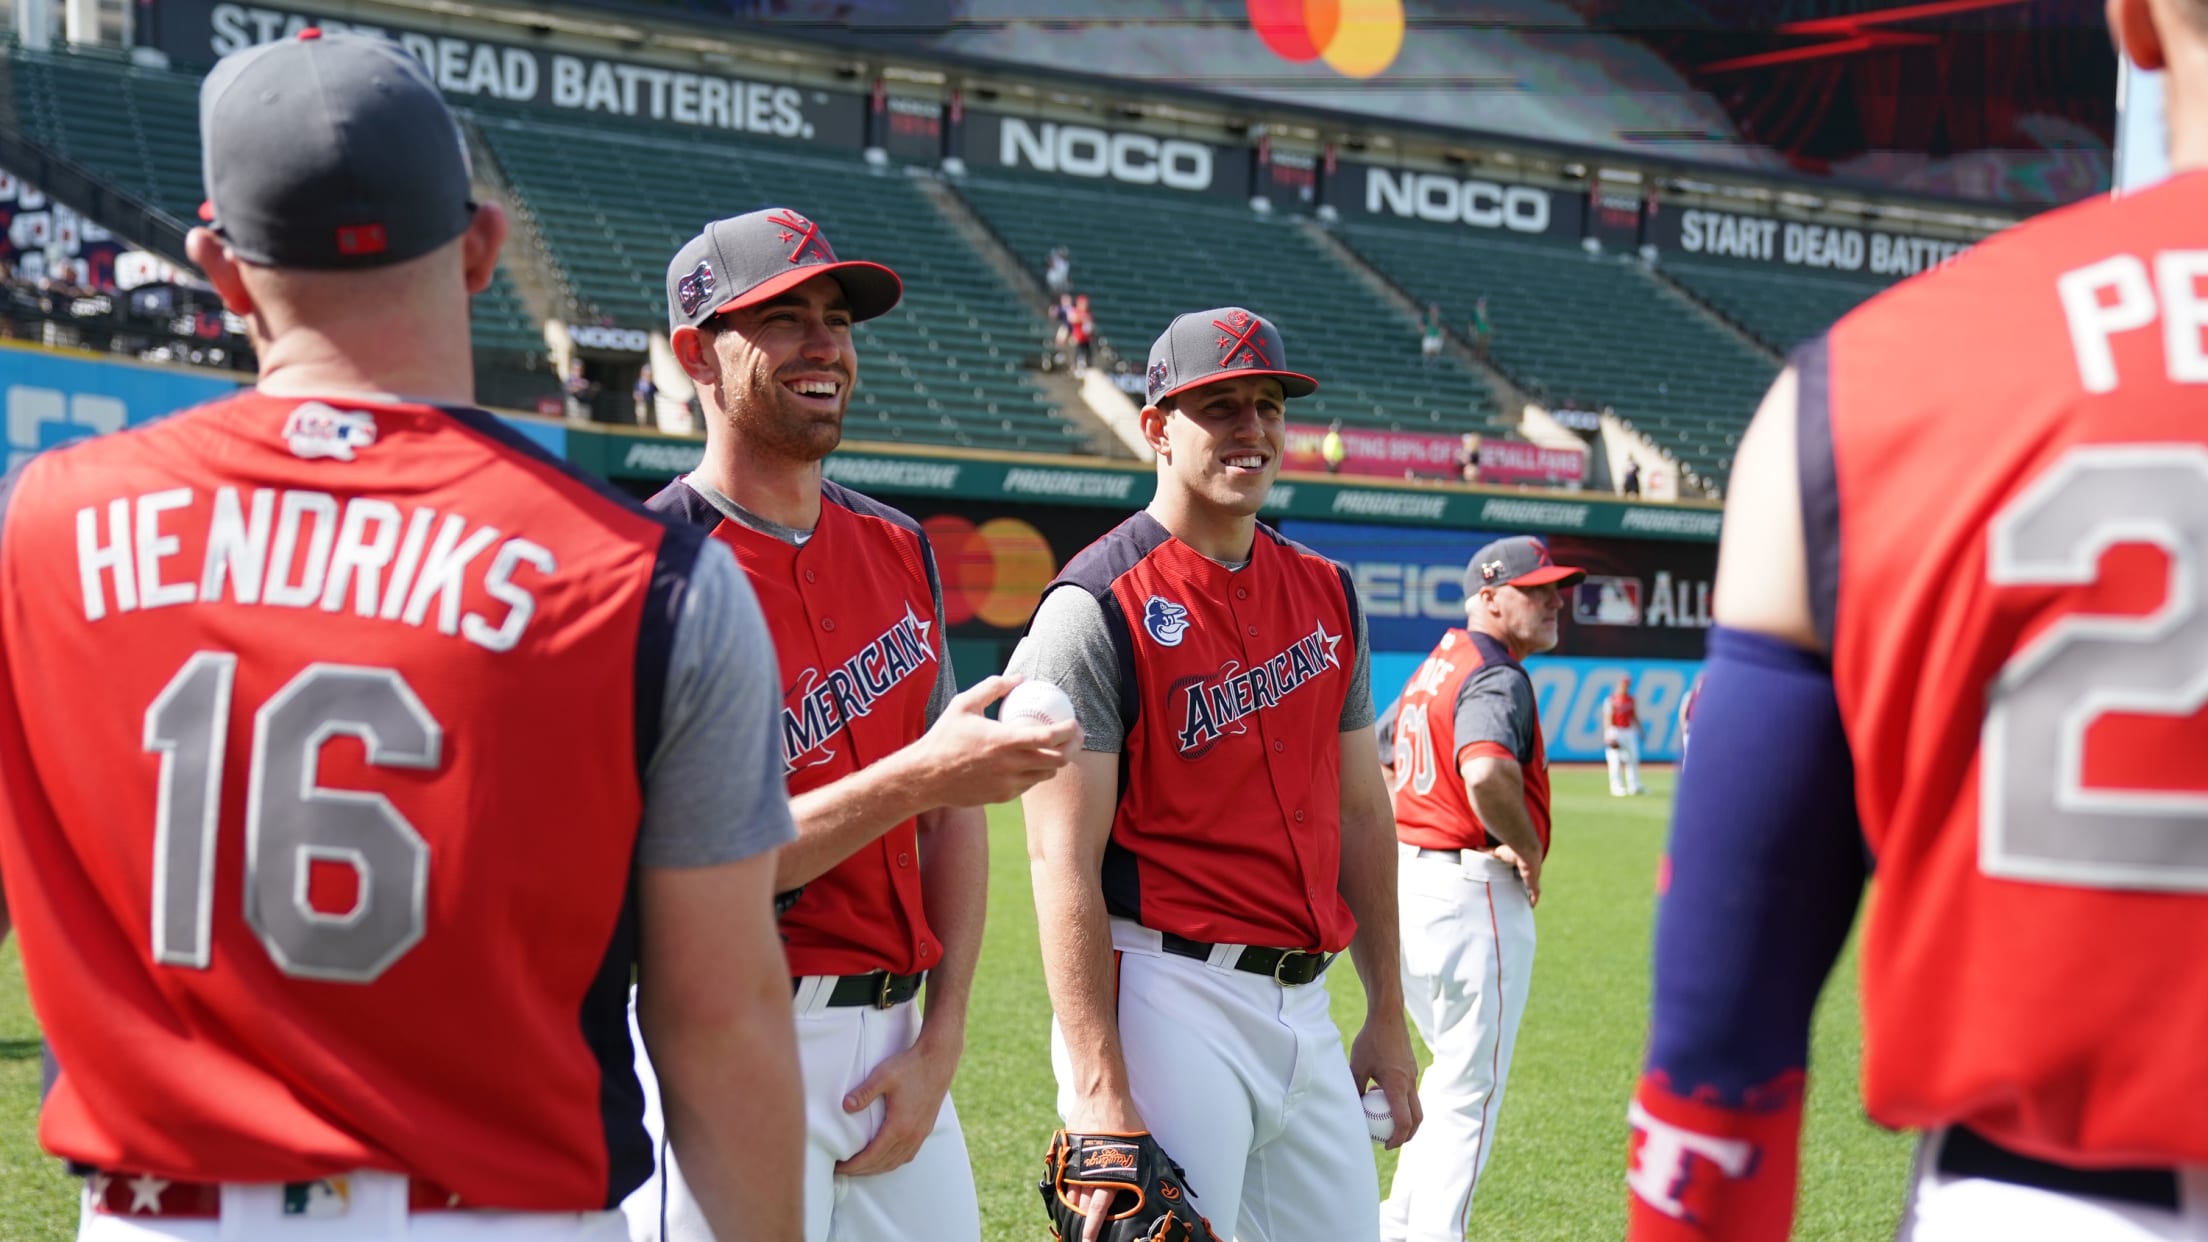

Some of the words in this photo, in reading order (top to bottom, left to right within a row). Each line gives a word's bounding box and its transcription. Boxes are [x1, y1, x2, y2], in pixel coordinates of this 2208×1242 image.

[1000, 116, 1213, 190] NOCO
[1366, 167, 1551, 233] NOCO
[1681, 210, 1777, 262] START
[1783, 222, 1866, 272] DEAD
[1003, 467, 1135, 499] PROGRESSIVE
[1333, 490, 1448, 519] PROGRESSIVE
[1481, 499, 1590, 527] PROGRESSIVE
[75, 485, 556, 652] HENDRIKS
[1178, 631, 1330, 752] AMERICAN
[1394, 703, 1437, 796] 60
[142, 649, 444, 984] 16
[1084, 1149, 1136, 1169] Rawlings
